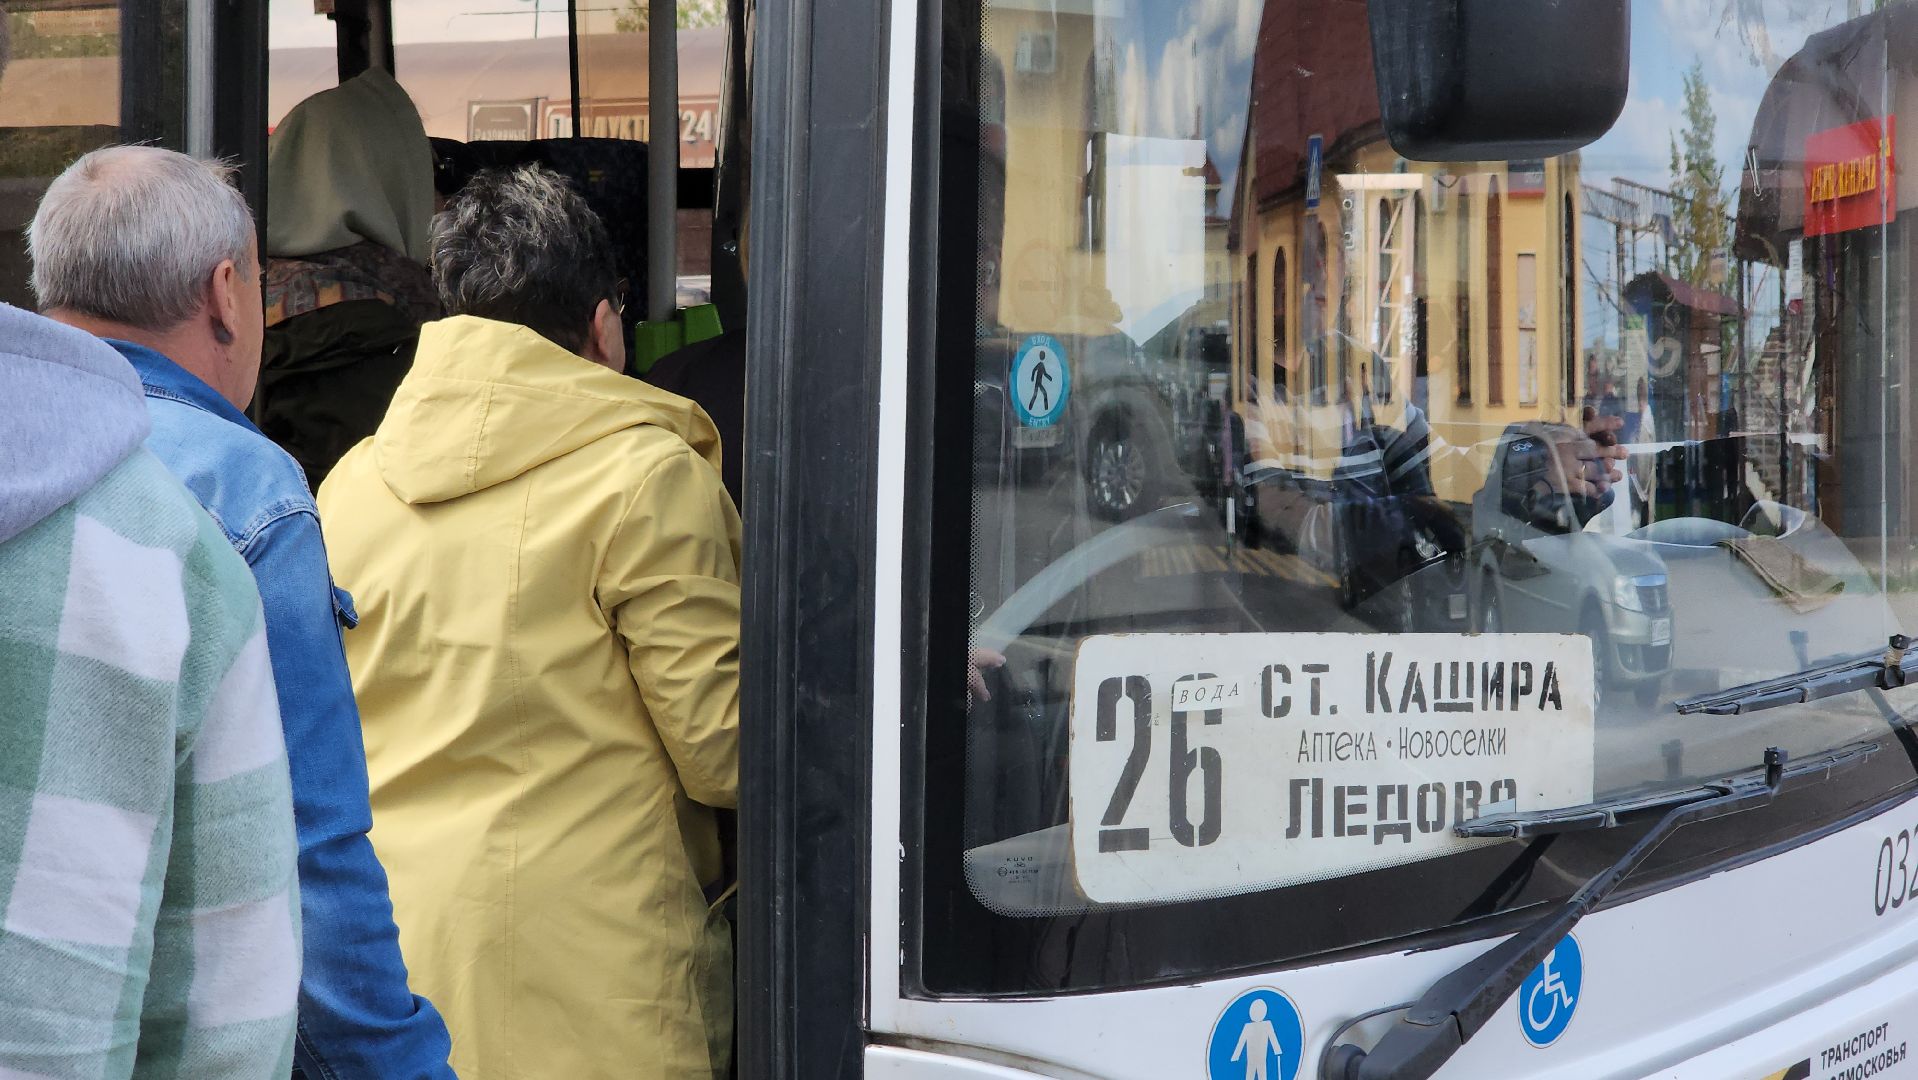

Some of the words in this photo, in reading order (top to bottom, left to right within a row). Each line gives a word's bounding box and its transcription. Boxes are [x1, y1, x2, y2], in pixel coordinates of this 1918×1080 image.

[682, 110, 712, 141] 24
[1179, 682, 1239, 704] ВОДА
[1261, 663, 1338, 719] СТ.
[1365, 651, 1563, 714] КАШИРА
[1095, 672, 1223, 853] 26
[1821, 1022, 1888, 1070] ТРАНСПОРТ
[1830, 1041, 1906, 1080] МОСКОВЬЯ
